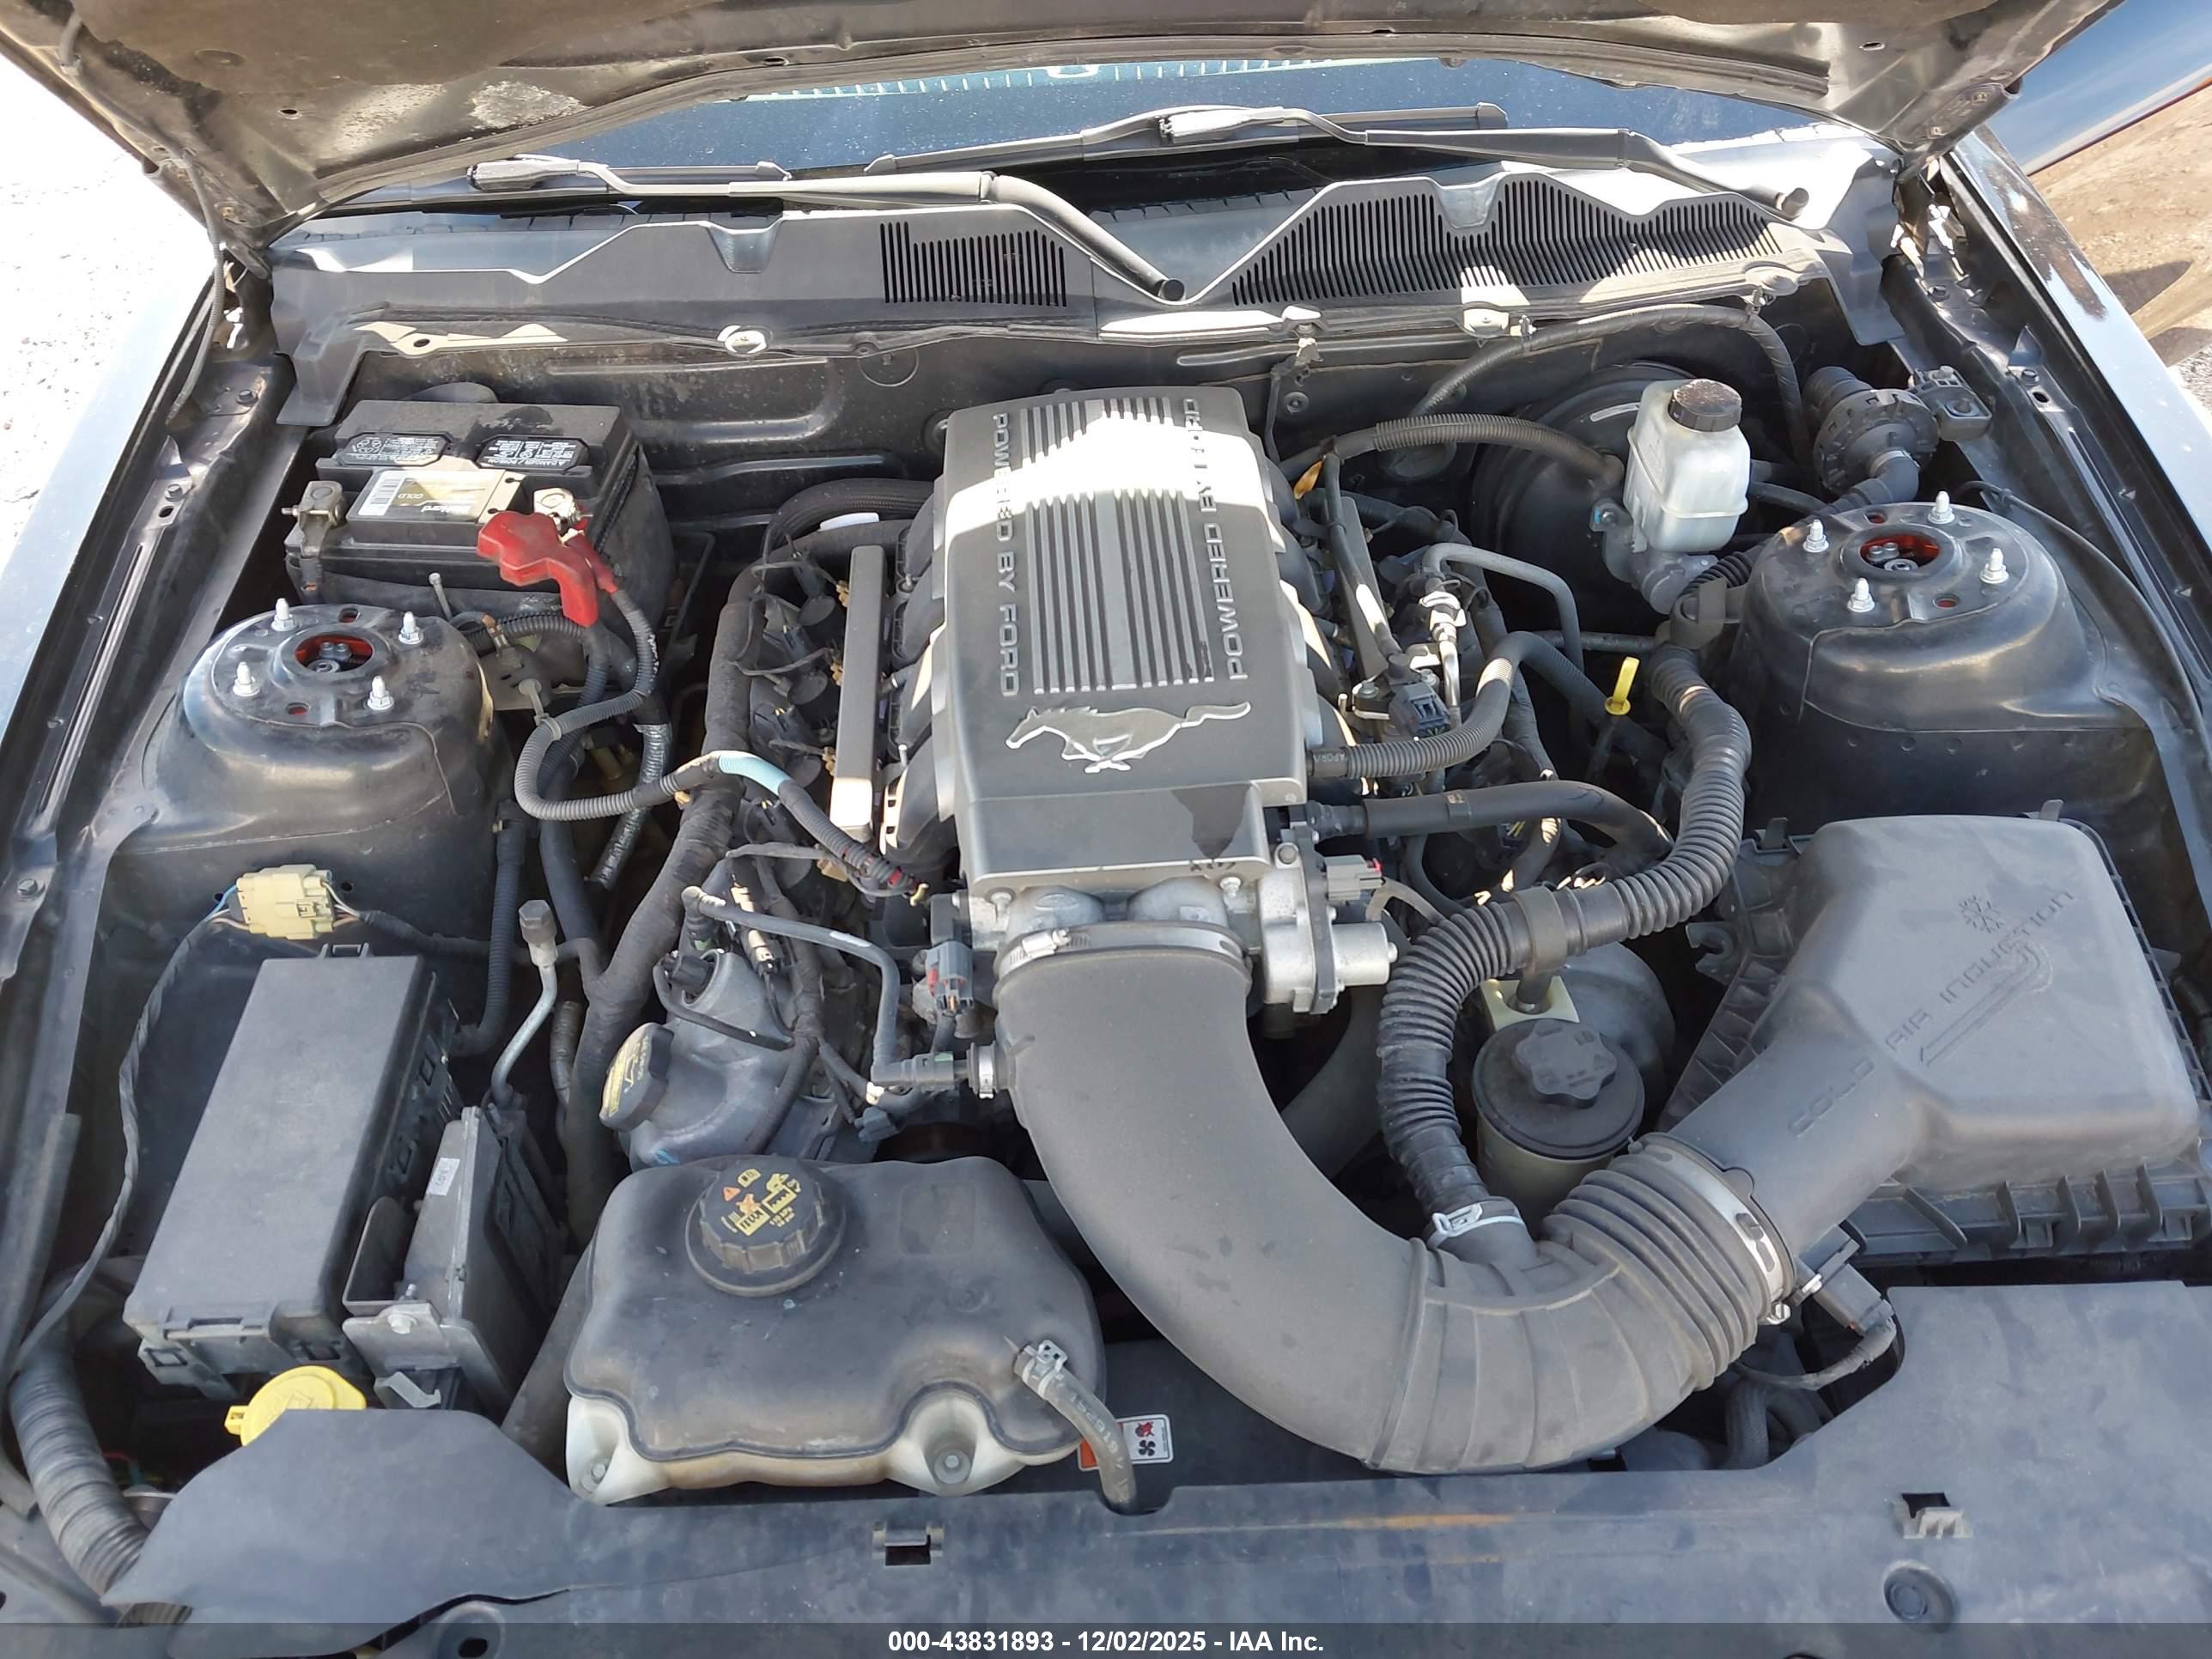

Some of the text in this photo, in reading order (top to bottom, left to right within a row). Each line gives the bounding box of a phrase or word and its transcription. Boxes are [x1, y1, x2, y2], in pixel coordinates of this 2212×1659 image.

[993, 412, 1020, 697] POWERED BY FORD
[1204, 523, 1249, 680] POWERED
[1788, 890, 2075, 1139] COLD AIR INDUCTION
